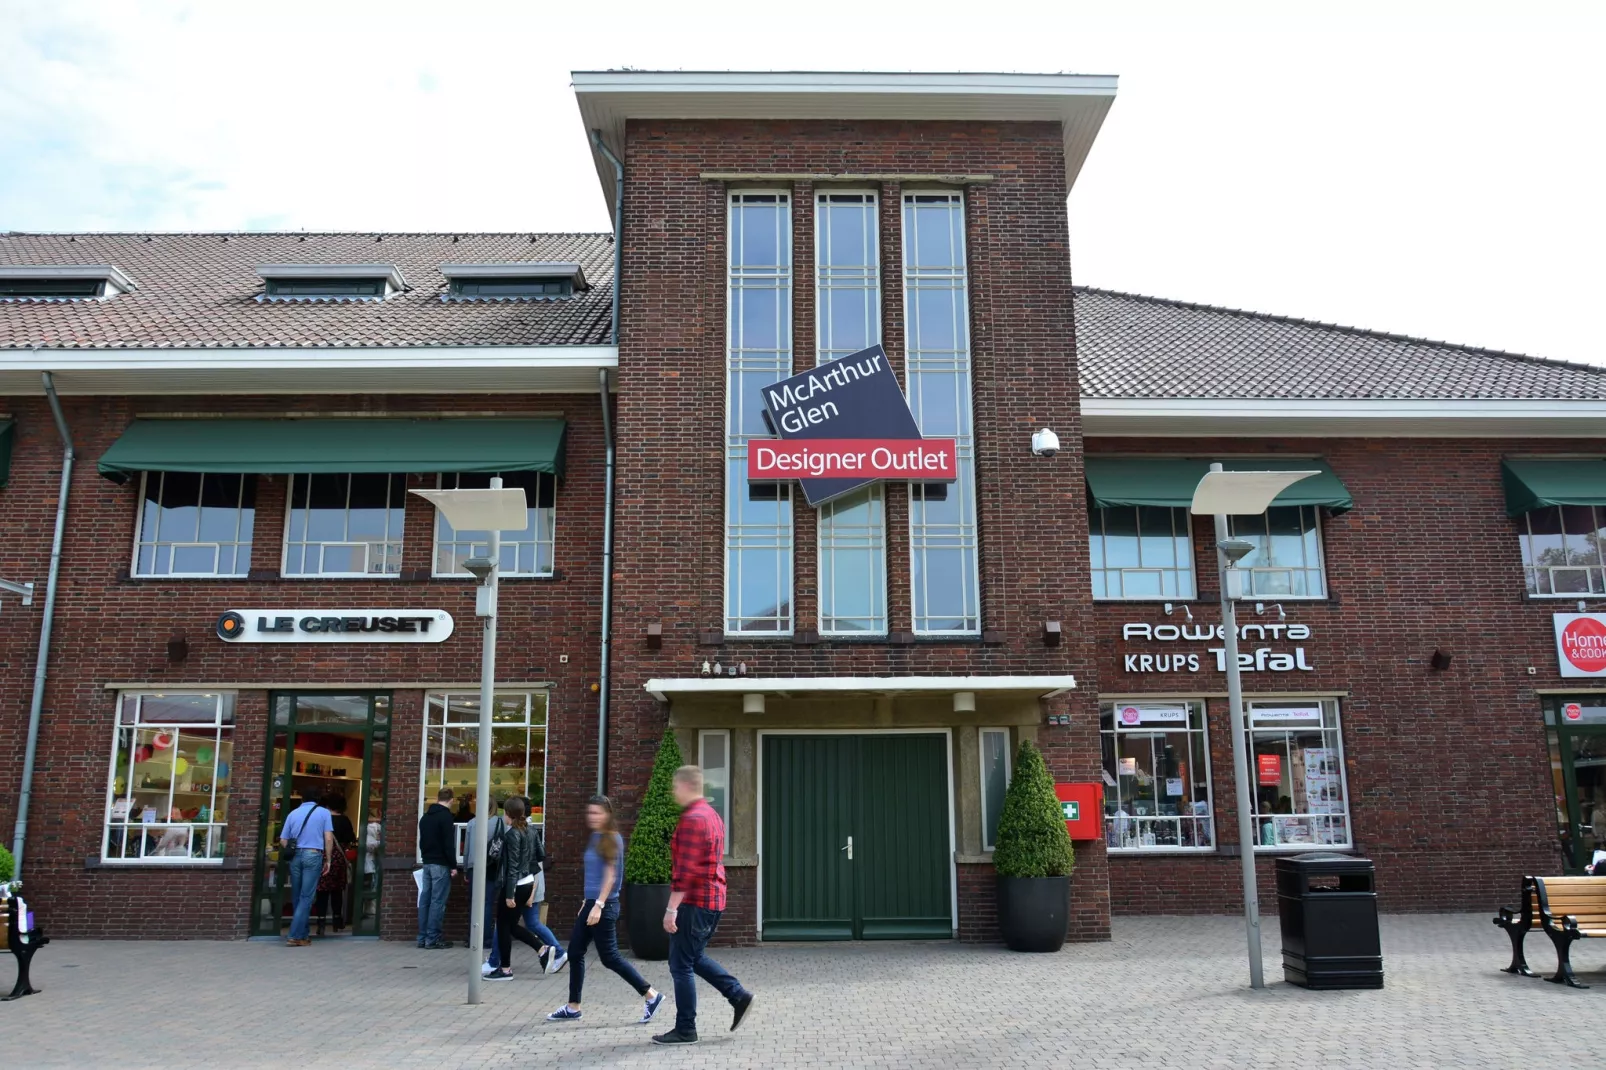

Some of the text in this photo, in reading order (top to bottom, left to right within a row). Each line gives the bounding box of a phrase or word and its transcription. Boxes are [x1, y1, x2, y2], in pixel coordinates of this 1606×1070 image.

[769, 354, 882, 412] McArthur
[780, 400, 839, 433] Glen
[756, 446, 949, 476] Designer Outlet
[257, 616, 295, 633] LE
[298, 616, 434, 633] CREUSET
[1124, 647, 1314, 672] KRUPS Tefal
